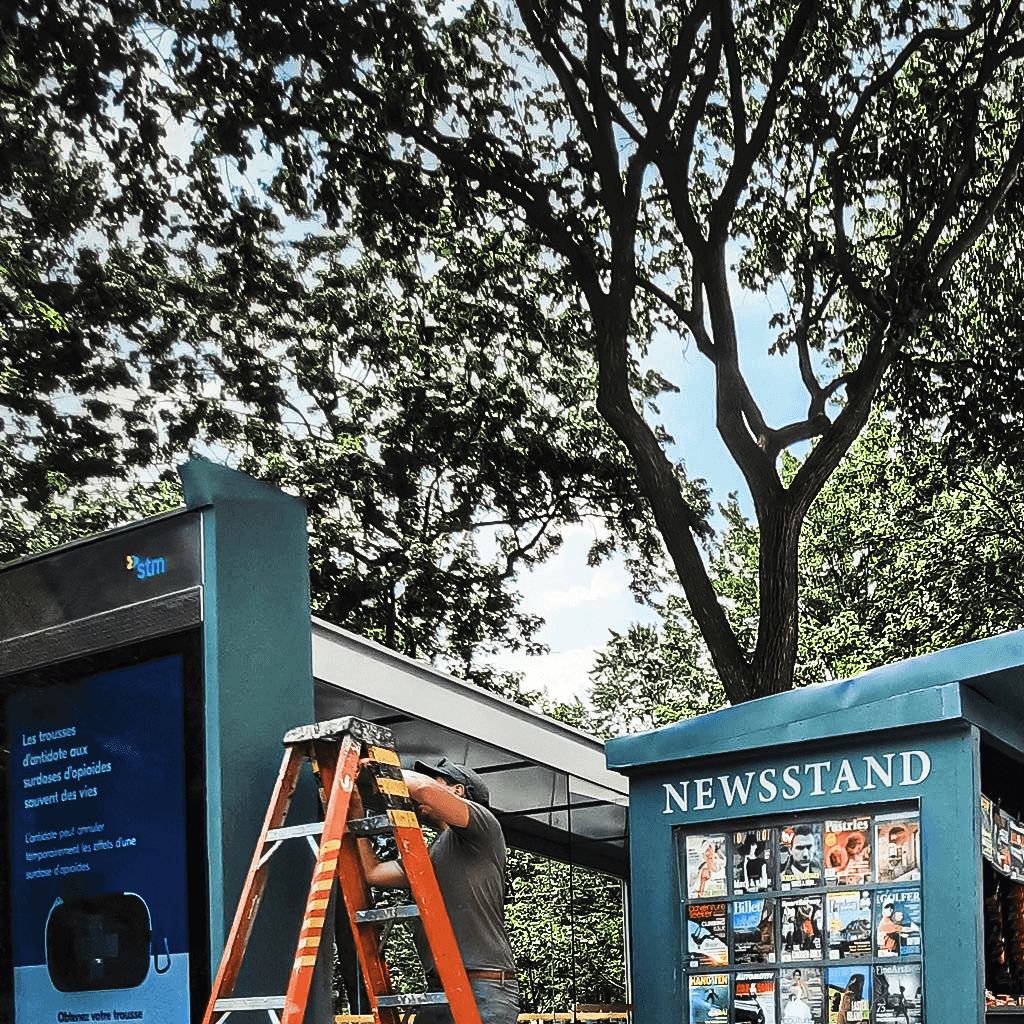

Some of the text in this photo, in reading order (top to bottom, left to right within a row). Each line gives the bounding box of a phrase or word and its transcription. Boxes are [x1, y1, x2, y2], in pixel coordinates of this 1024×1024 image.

[137, 557, 166, 579] stm
[23, 727, 77, 747] Les trousses
[23, 746, 89, 767] d'antidote aux
[23, 772, 62, 789] surdoses
[662, 749, 932, 814] NEWSSTAND
[24, 785, 98, 809] souvent des vies
[116, 837, 137, 848] d'une
[57, 1009, 144, 1023] Obtenez votre trousse
